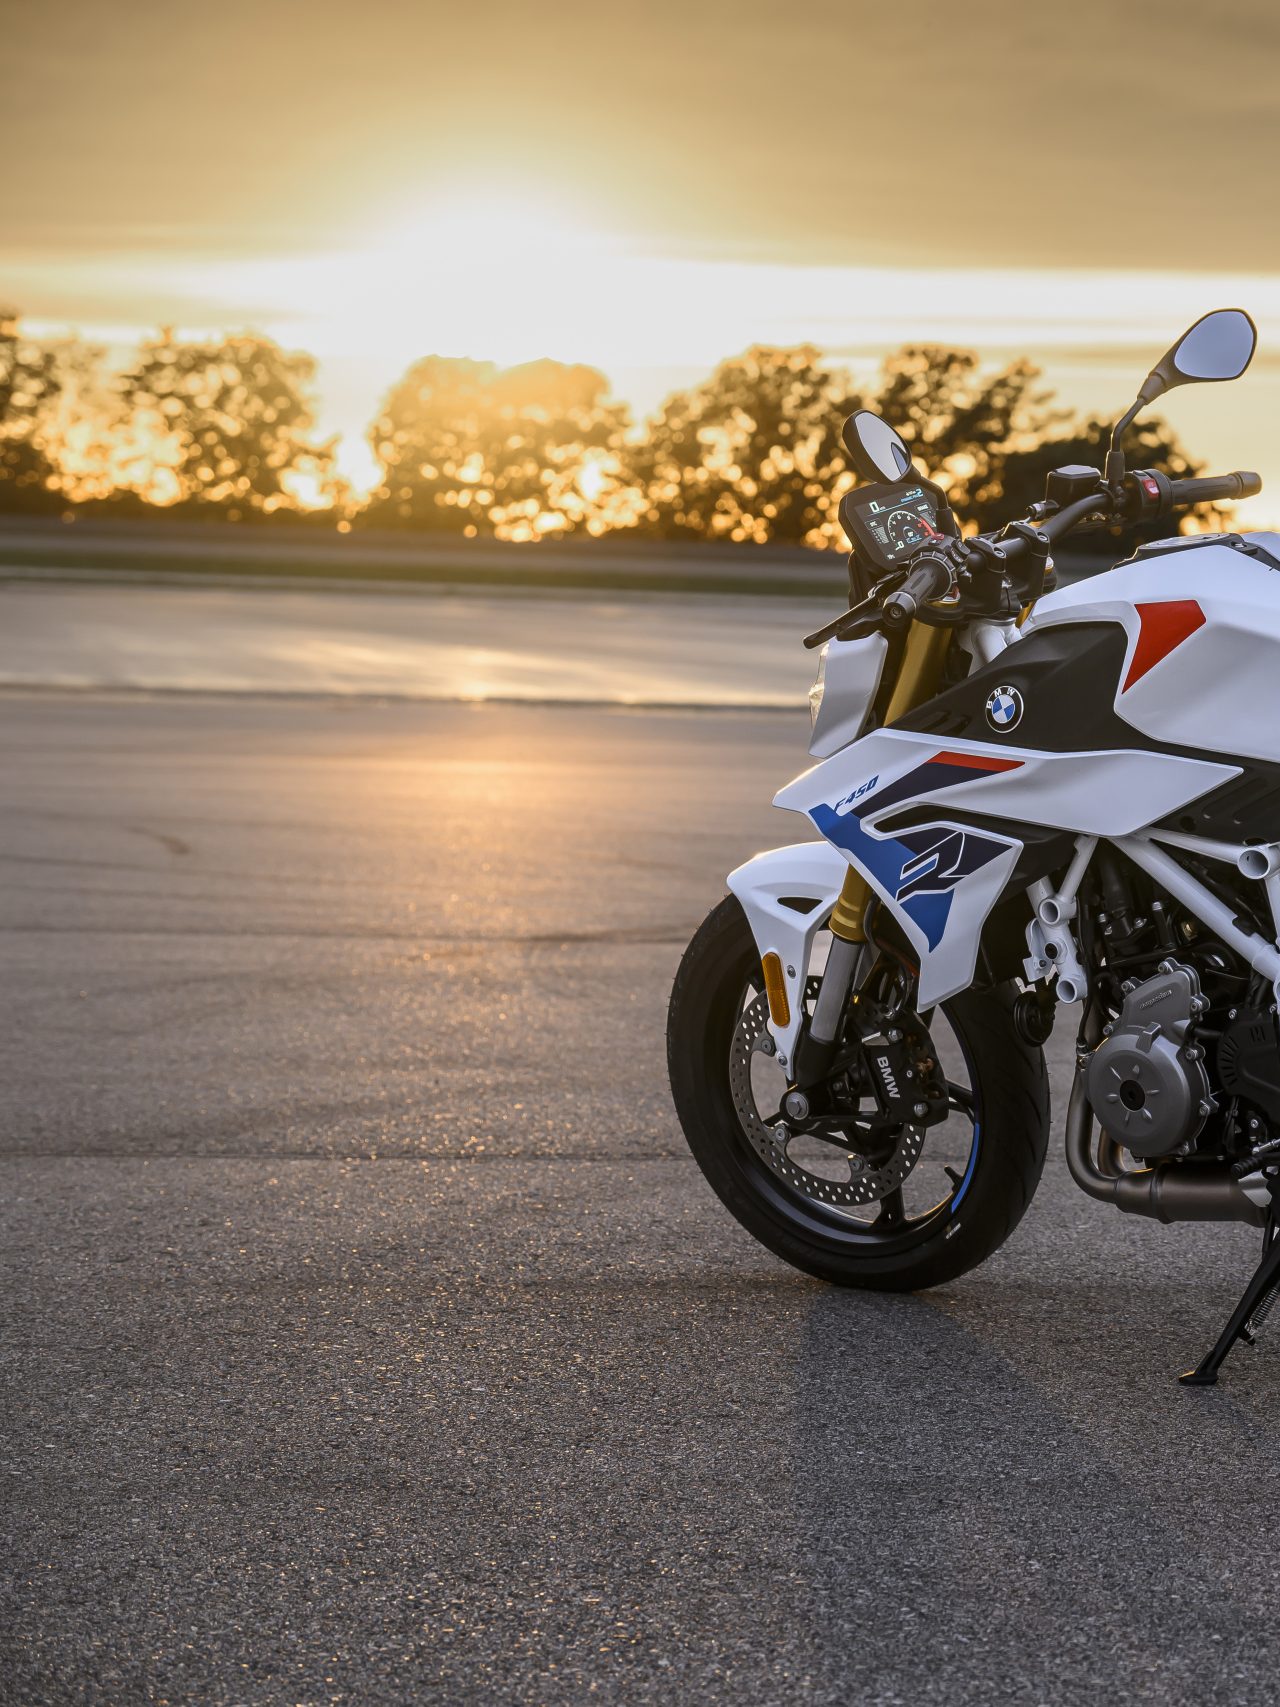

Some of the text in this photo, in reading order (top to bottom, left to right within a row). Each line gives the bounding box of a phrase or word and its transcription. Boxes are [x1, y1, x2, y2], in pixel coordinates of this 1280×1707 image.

[869, 501, 879, 513] 0
[986, 687, 1016, 709] BMW
[834, 774, 880, 812] F 450
[876, 1056, 901, 1098] BMW
